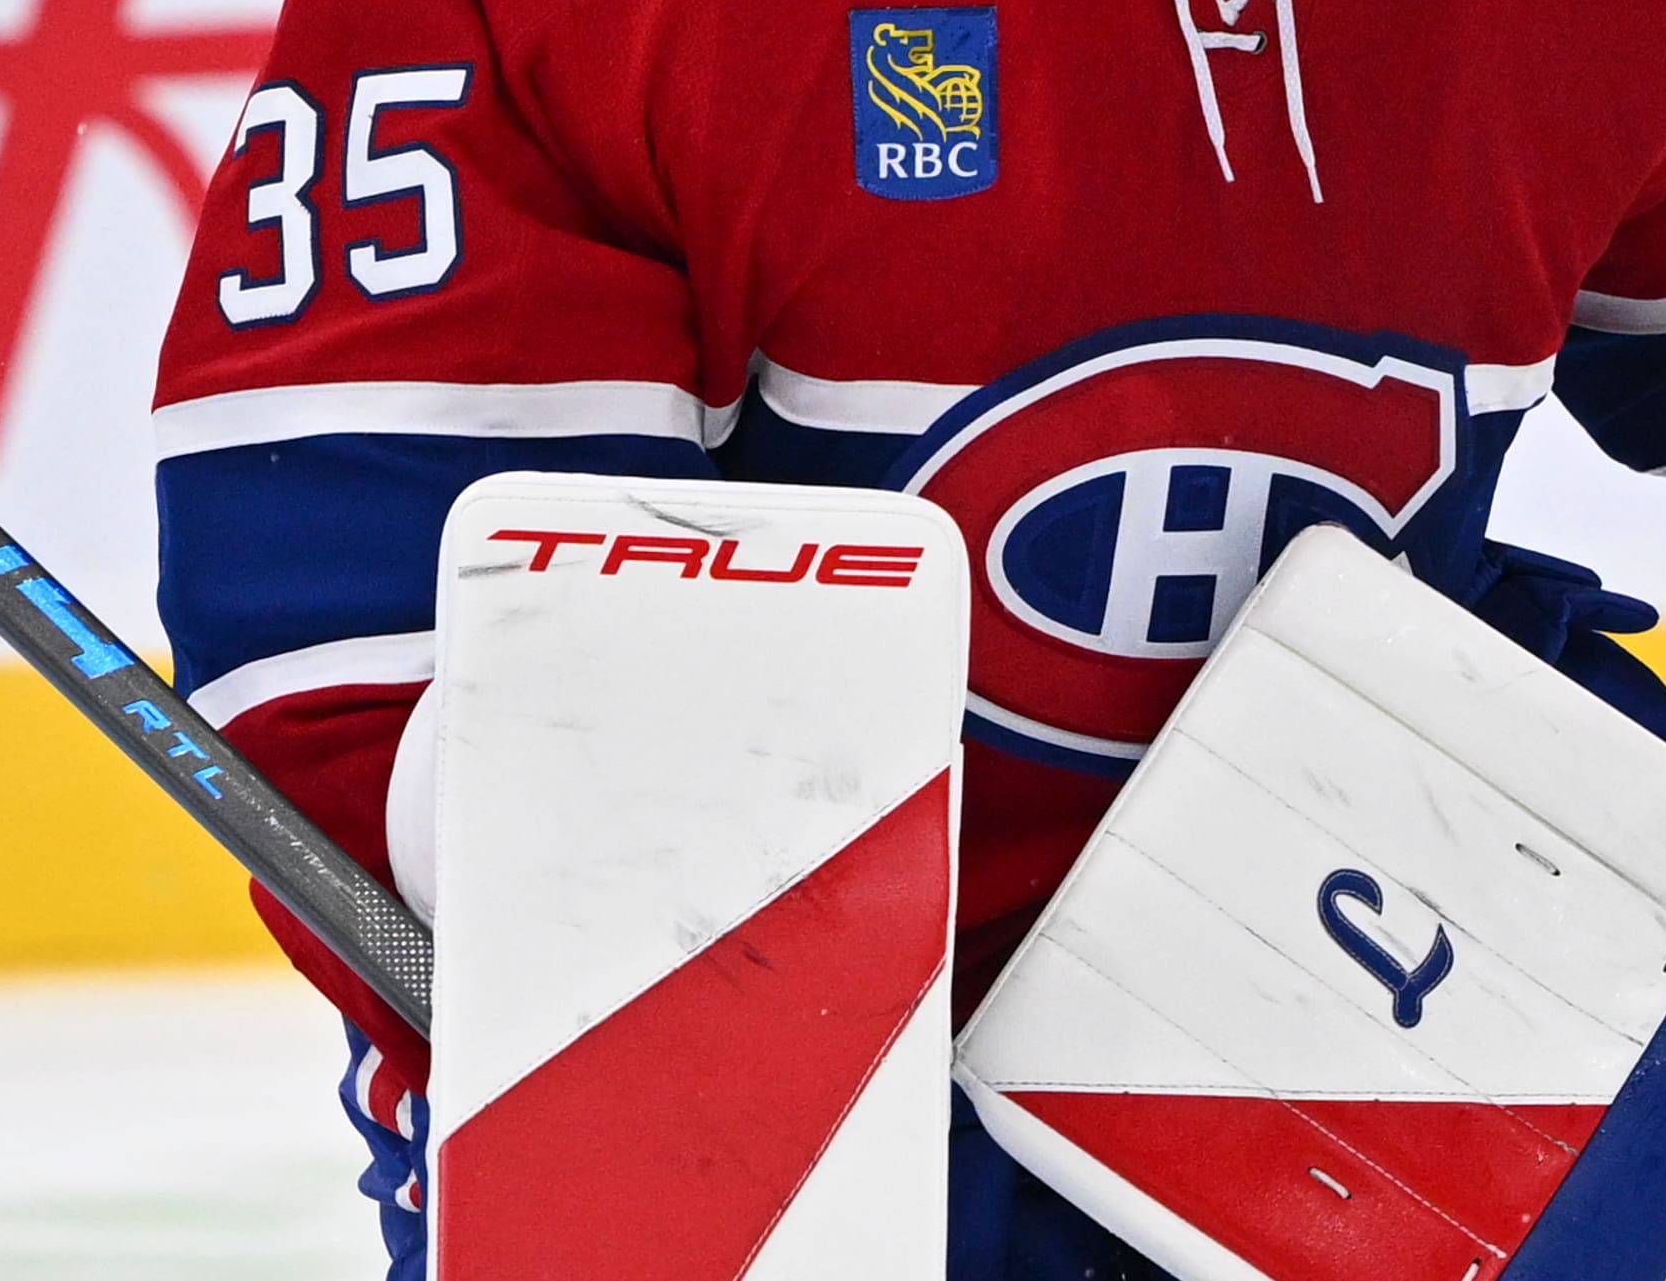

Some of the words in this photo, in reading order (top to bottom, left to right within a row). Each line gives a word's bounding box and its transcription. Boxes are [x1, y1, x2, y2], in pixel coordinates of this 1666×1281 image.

[215, 62, 472, 330] 35
[876, 141, 979, 179] RBC
[487, 529, 924, 588] TRUE
[122, 699, 223, 799] RTL
